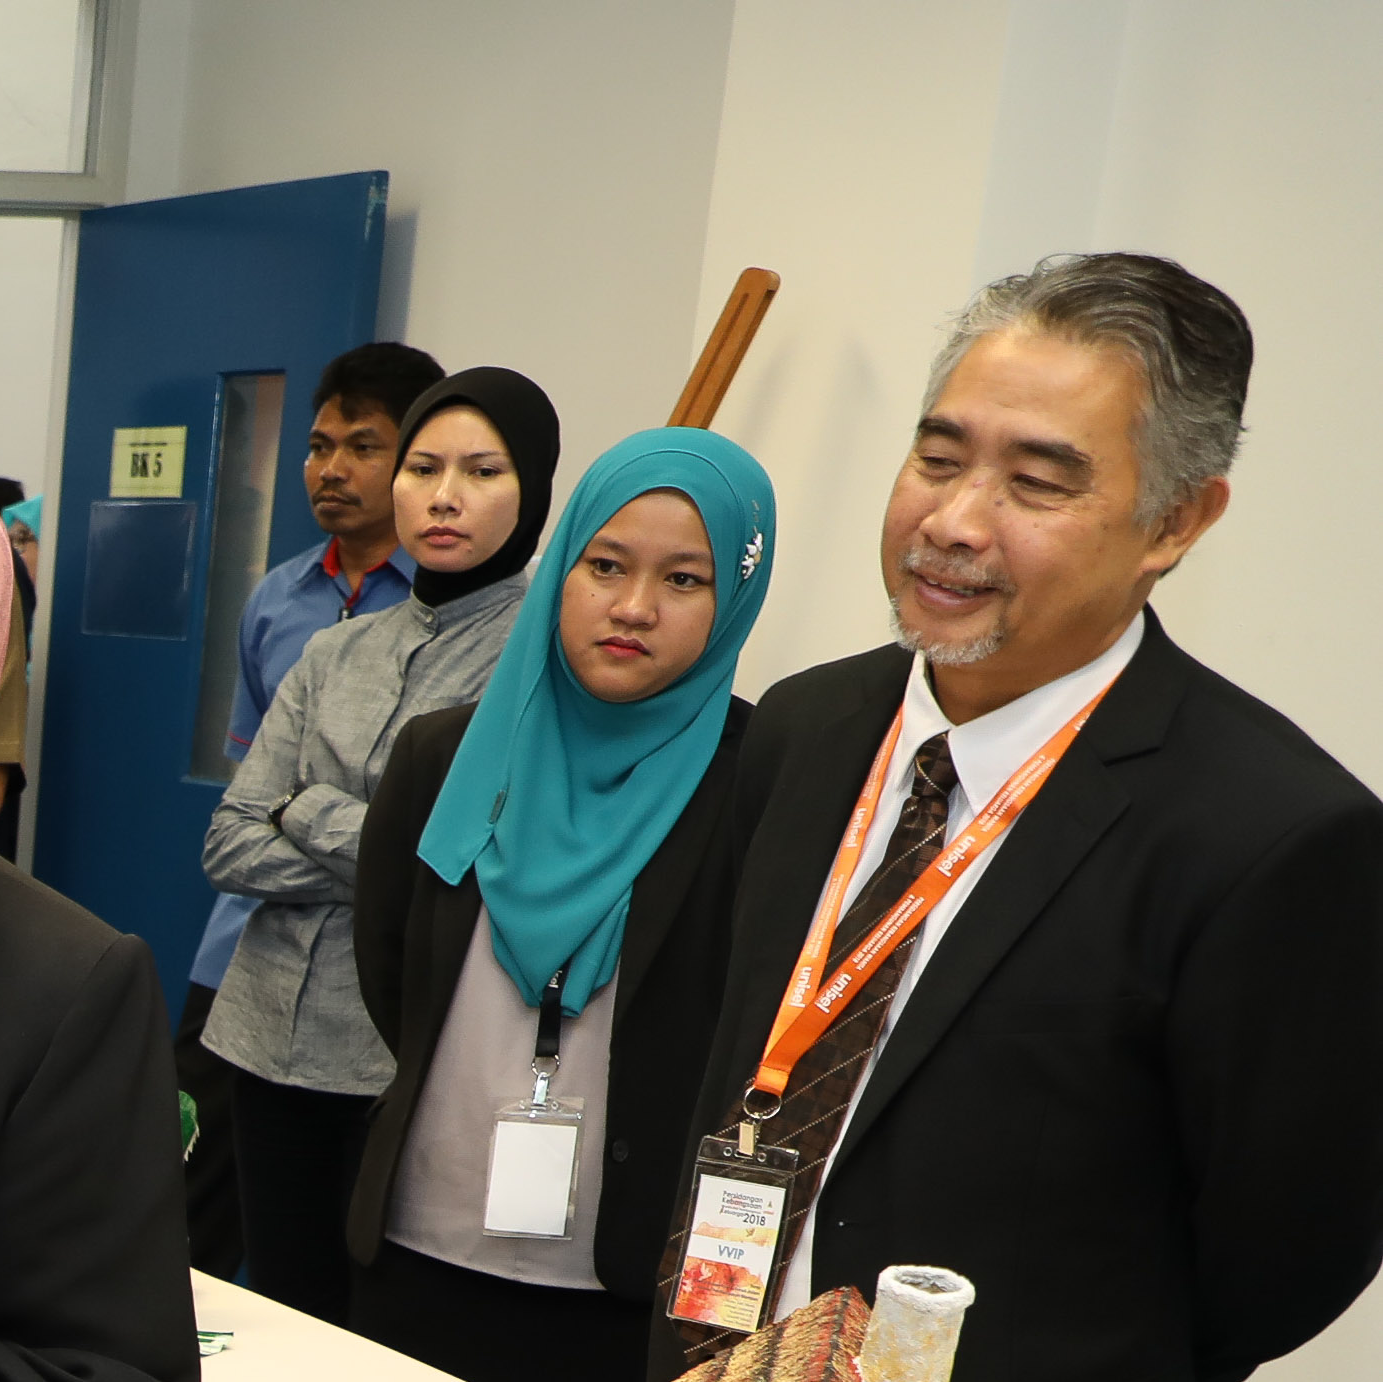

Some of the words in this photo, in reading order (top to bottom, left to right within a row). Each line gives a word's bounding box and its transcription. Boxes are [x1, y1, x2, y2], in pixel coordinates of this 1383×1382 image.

[153, 452, 163, 478] 5
[937, 835, 976, 878] unisel
[789, 965, 812, 1008] unisel
[815, 973, 852, 1014] unisel
[743, 1213, 766, 1226] 2018
[718, 1245, 745, 1260] VVIP
